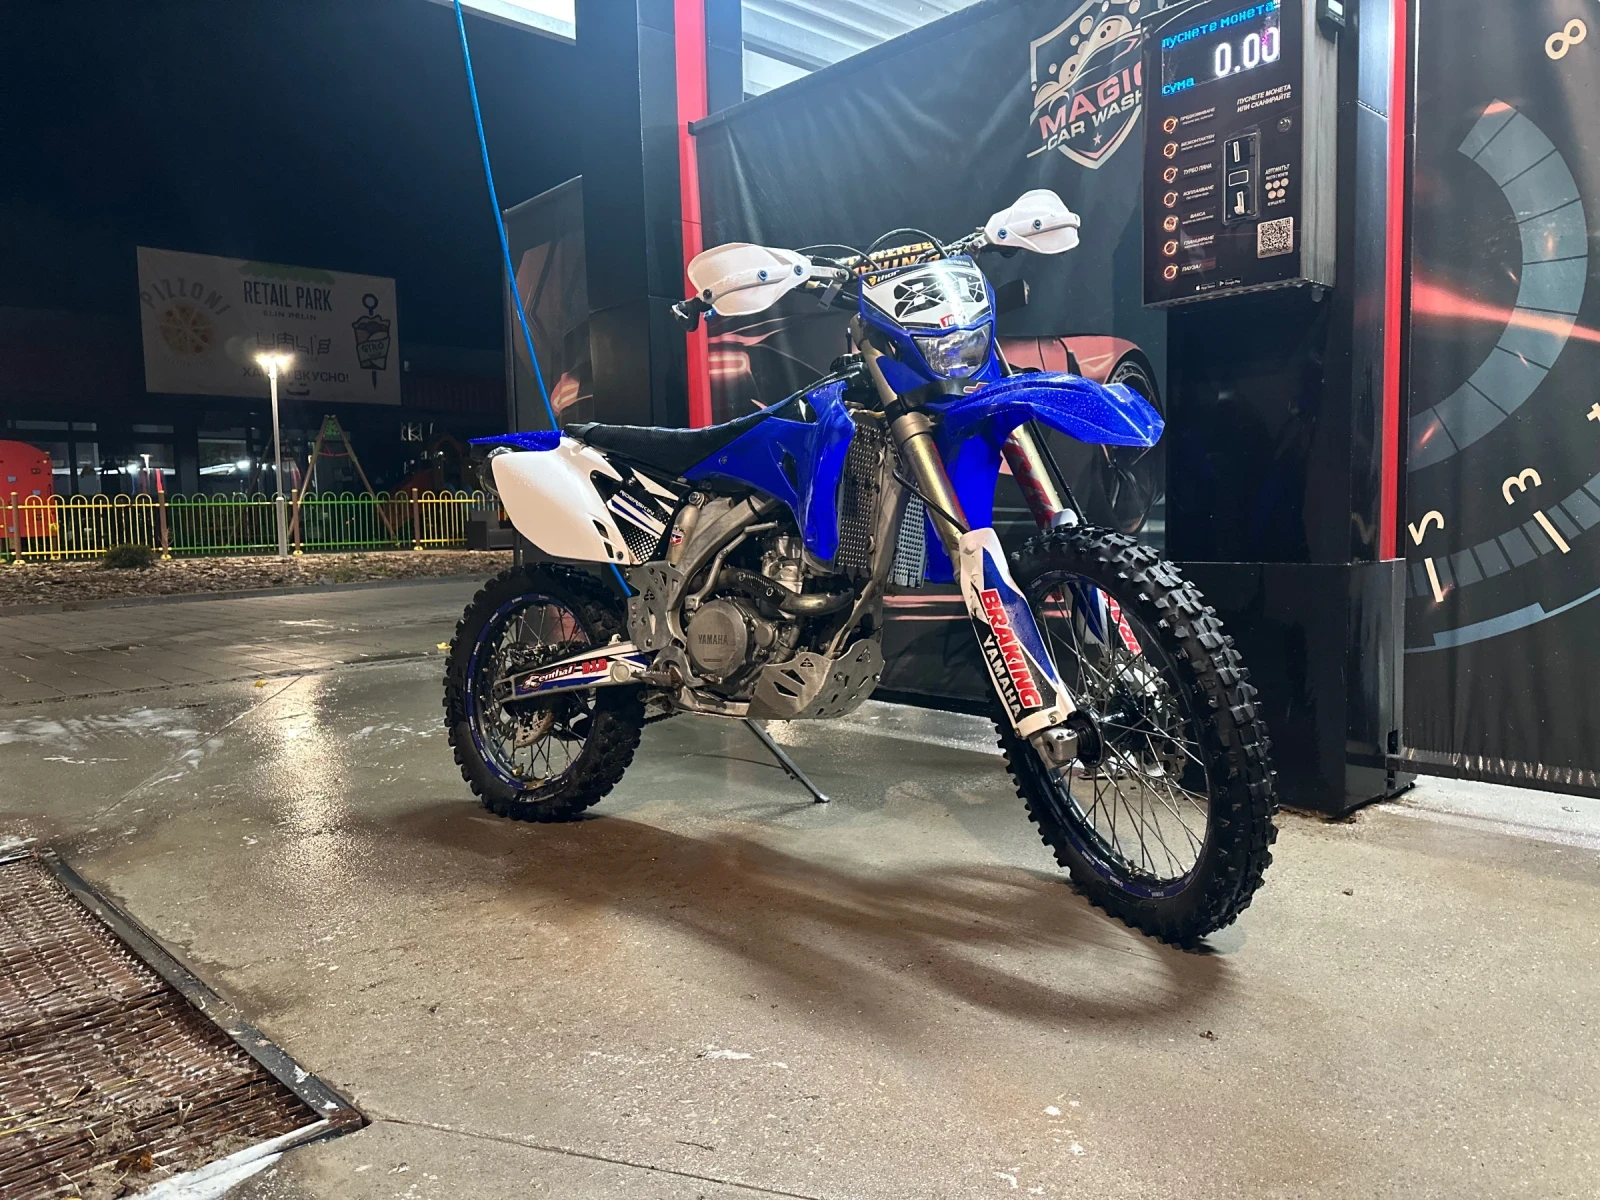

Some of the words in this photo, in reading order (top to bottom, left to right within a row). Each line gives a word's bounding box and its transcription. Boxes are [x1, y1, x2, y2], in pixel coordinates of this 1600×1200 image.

[1215, 27, 1279, 78] 0.00
[1237, 90, 1265, 105] ПУСНЕТЕ
[1265, 84, 1292, 98] МОНЕТА
[1237, 103, 1250, 113] ИЛИ
[1250, 91, 1292, 110] СКАНИРАЙТЕ
[1047, 120, 1086, 150] CAR
[877, 269, 900, 282] thor
[140, 276, 232, 316] PIZZONI
[243, 280, 292, 308] RETAIL
[296, 286, 333, 312] PARK
[263, 311, 285, 319] ELIN
[288, 312, 317, 321] PELIN
[361, 341, 384, 355] GYRO
[698, 634, 728, 646] YAMAHA
[981, 589, 1043, 709] BRAKING
[983, 633, 1021, 719] YAMAHA
